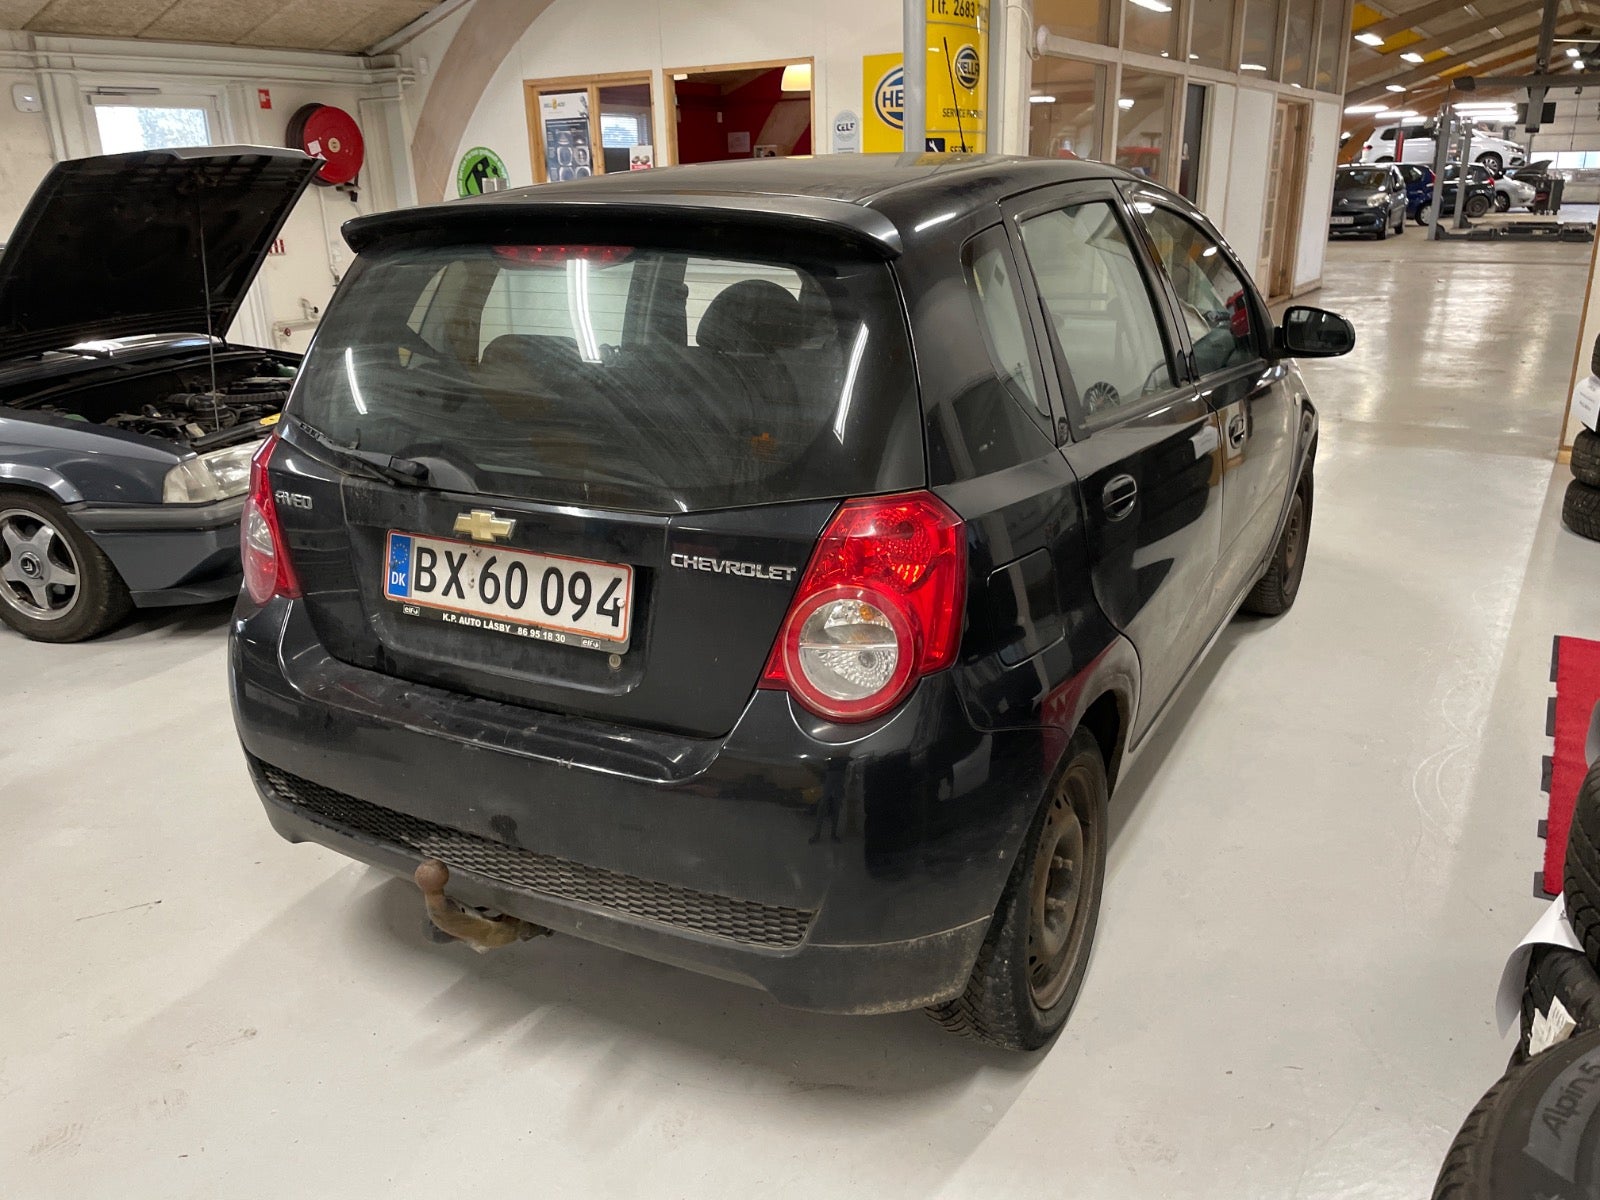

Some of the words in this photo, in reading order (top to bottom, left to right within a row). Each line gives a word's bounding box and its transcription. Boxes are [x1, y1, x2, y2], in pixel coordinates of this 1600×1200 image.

[954, 0, 975, 18] 2683
[391, 571, 406, 587] DK
[670, 553, 797, 581] CHEVROLET
[414, 546, 468, 600] BX
[478, 555, 528, 610] 60
[540, 566, 623, 628] 094
[442, 612, 458, 623] K.P.
[459, 615, 482, 628] AUTO
[517, 626, 528, 636] 86
[529, 629, 541, 639] 95
[542, 631, 553, 641] 18
[555, 633, 566, 643] 30
